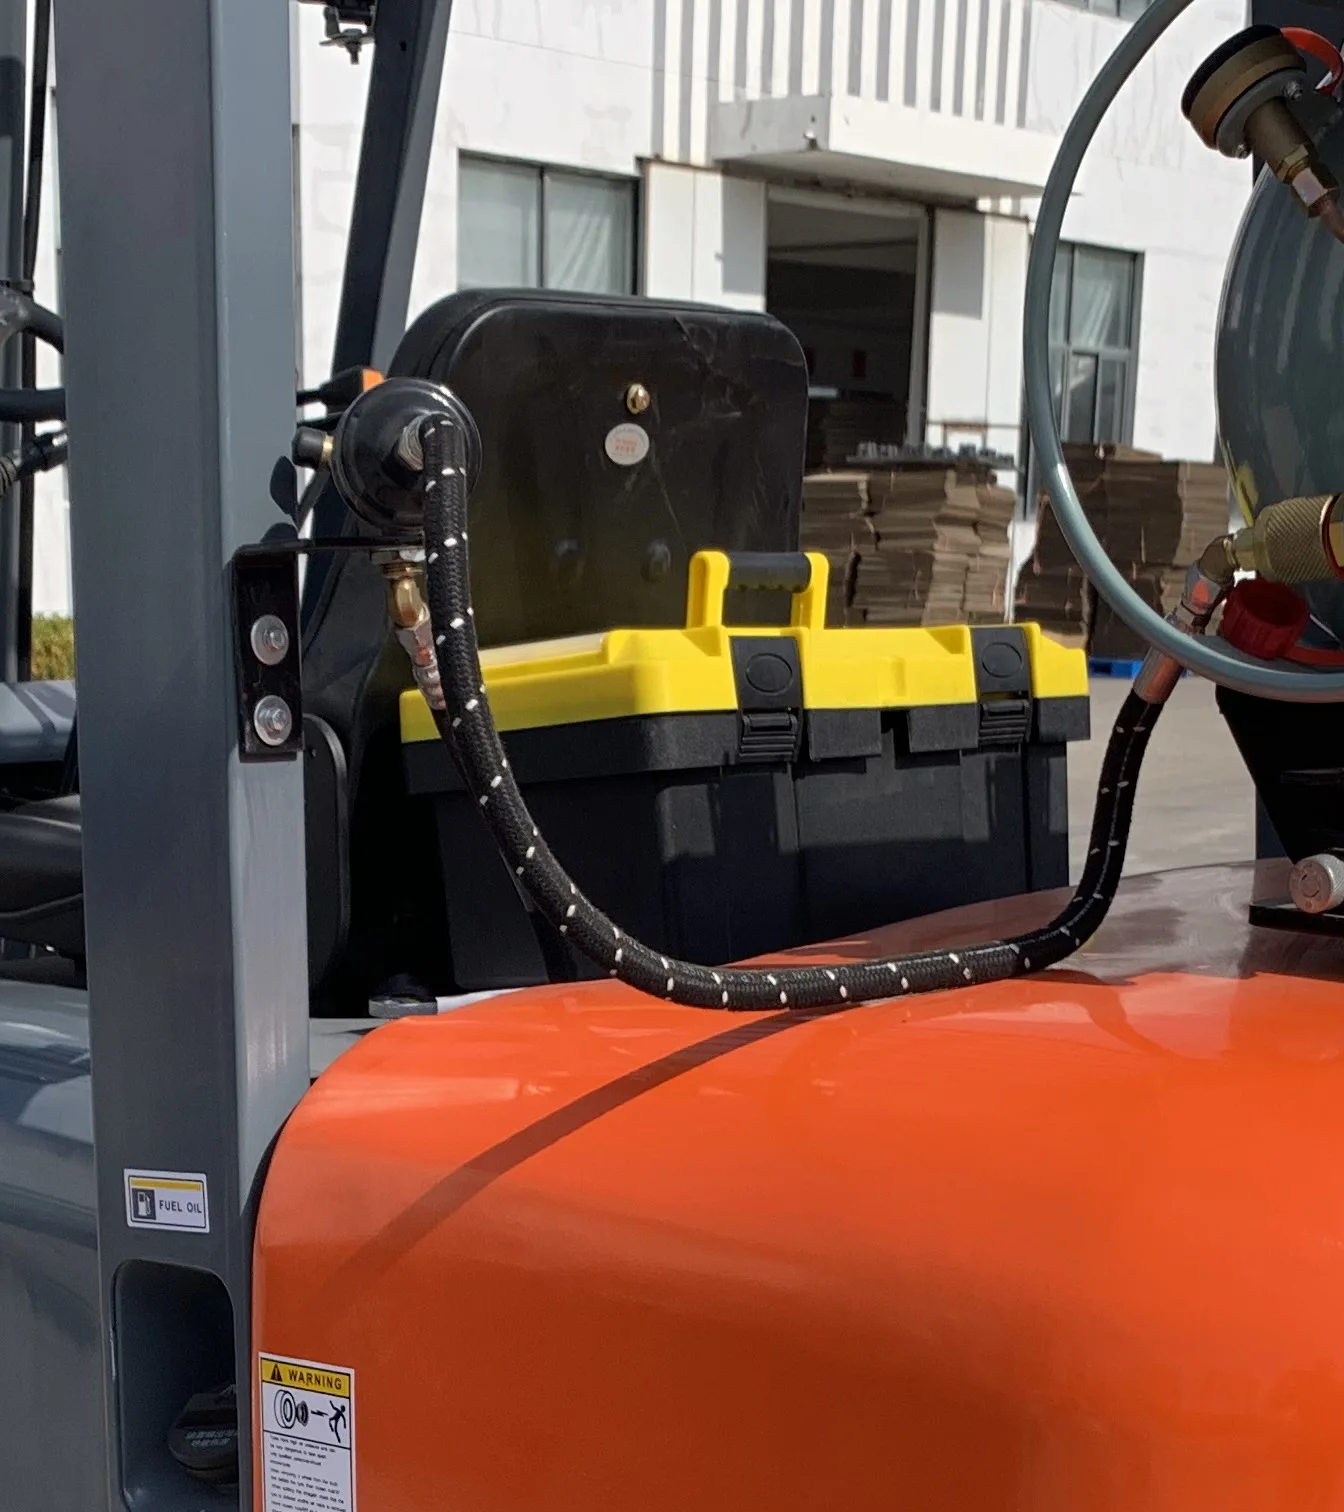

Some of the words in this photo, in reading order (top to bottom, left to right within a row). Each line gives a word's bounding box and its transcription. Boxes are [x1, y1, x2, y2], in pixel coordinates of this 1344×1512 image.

[159, 1199, 183, 1212] FUEL
[186, 1201, 202, 1214] OIL
[288, 1369, 343, 1390] WARNING
